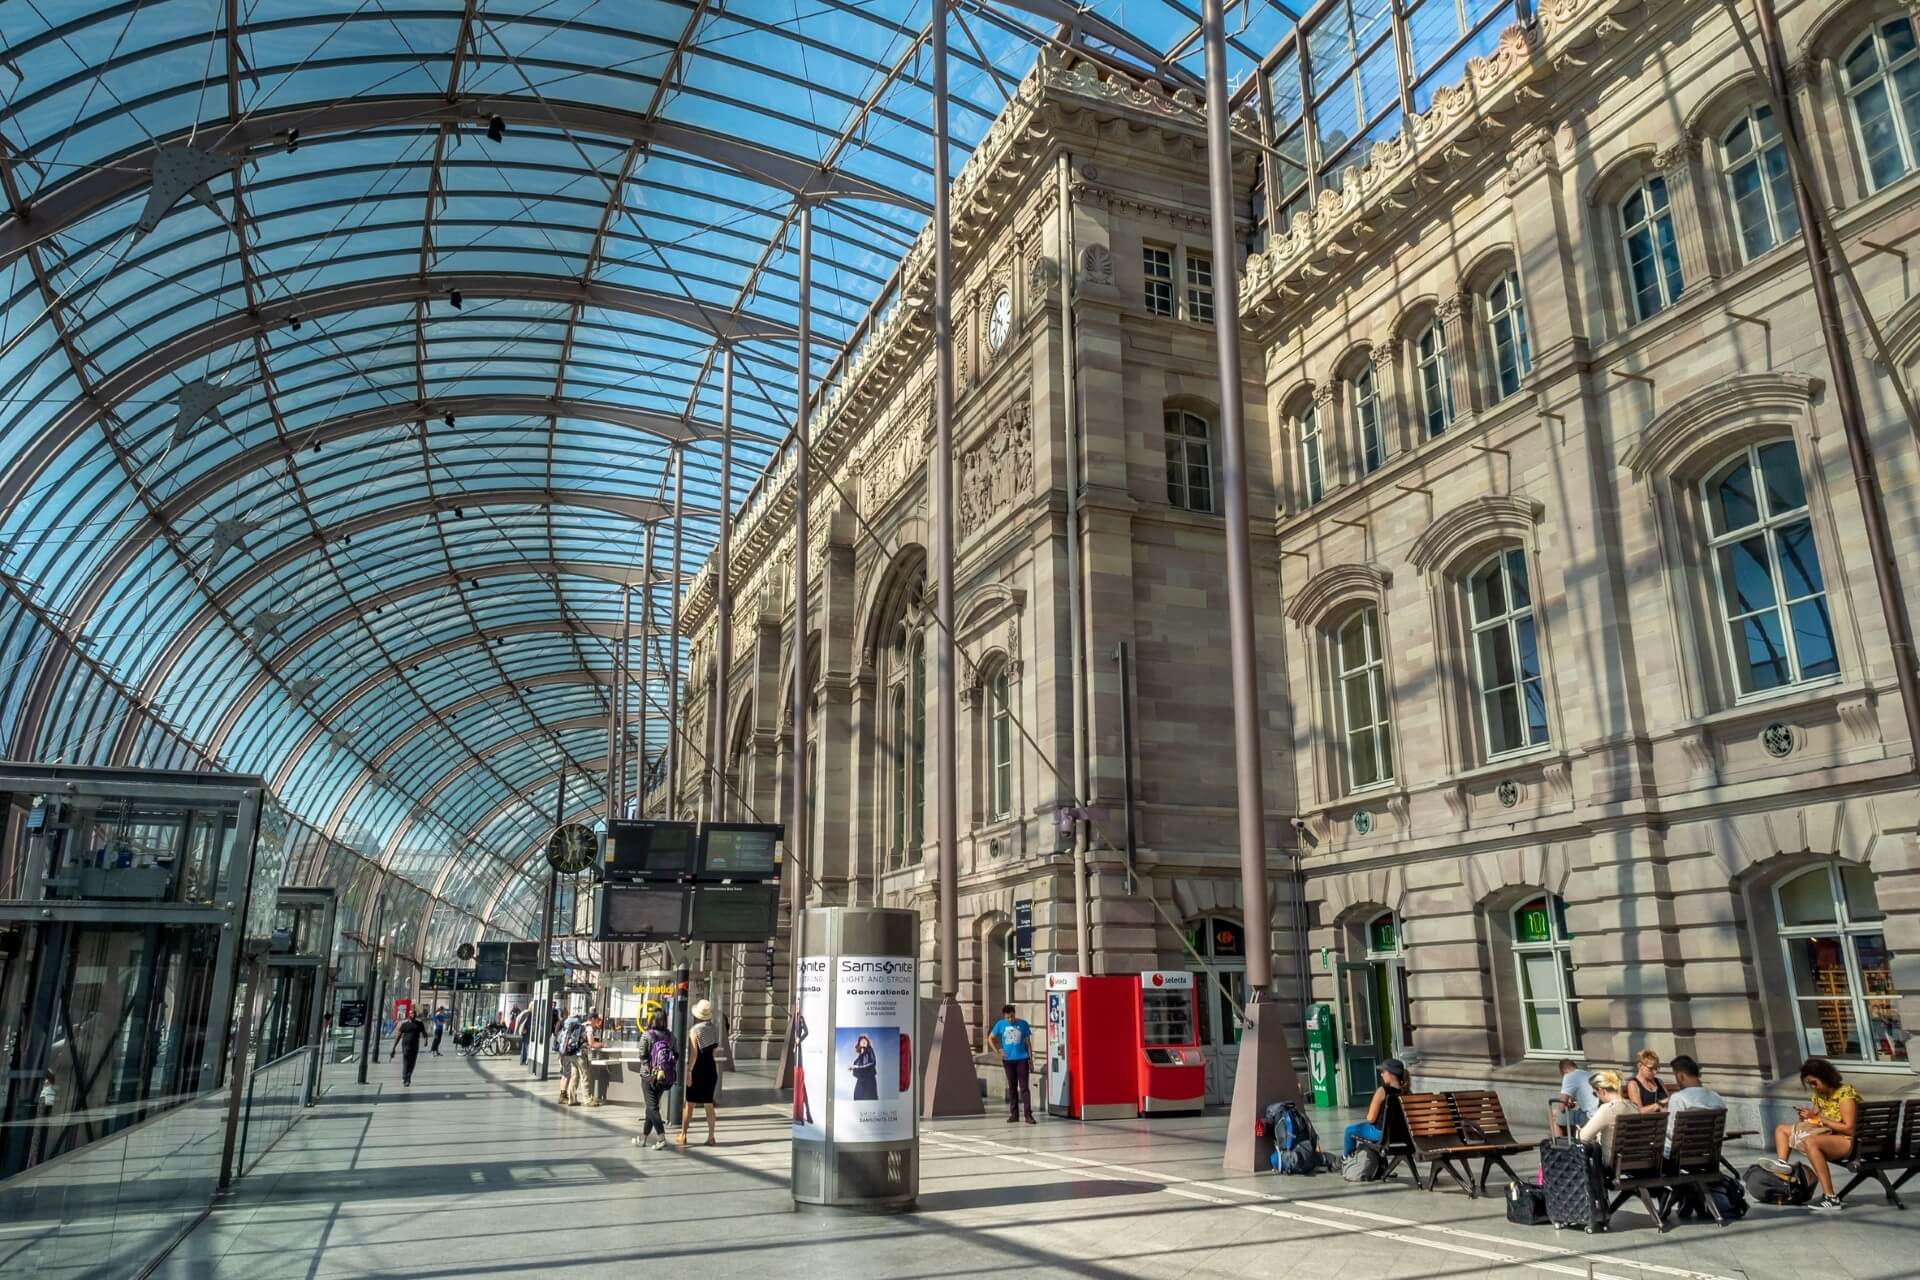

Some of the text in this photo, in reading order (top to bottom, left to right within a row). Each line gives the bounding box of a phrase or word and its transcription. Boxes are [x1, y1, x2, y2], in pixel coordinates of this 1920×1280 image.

[841, 960, 913, 974] Samsonite
[841, 975, 912, 984] LIGHT AND STRONG
[1165, 976, 1187, 984] selecta
